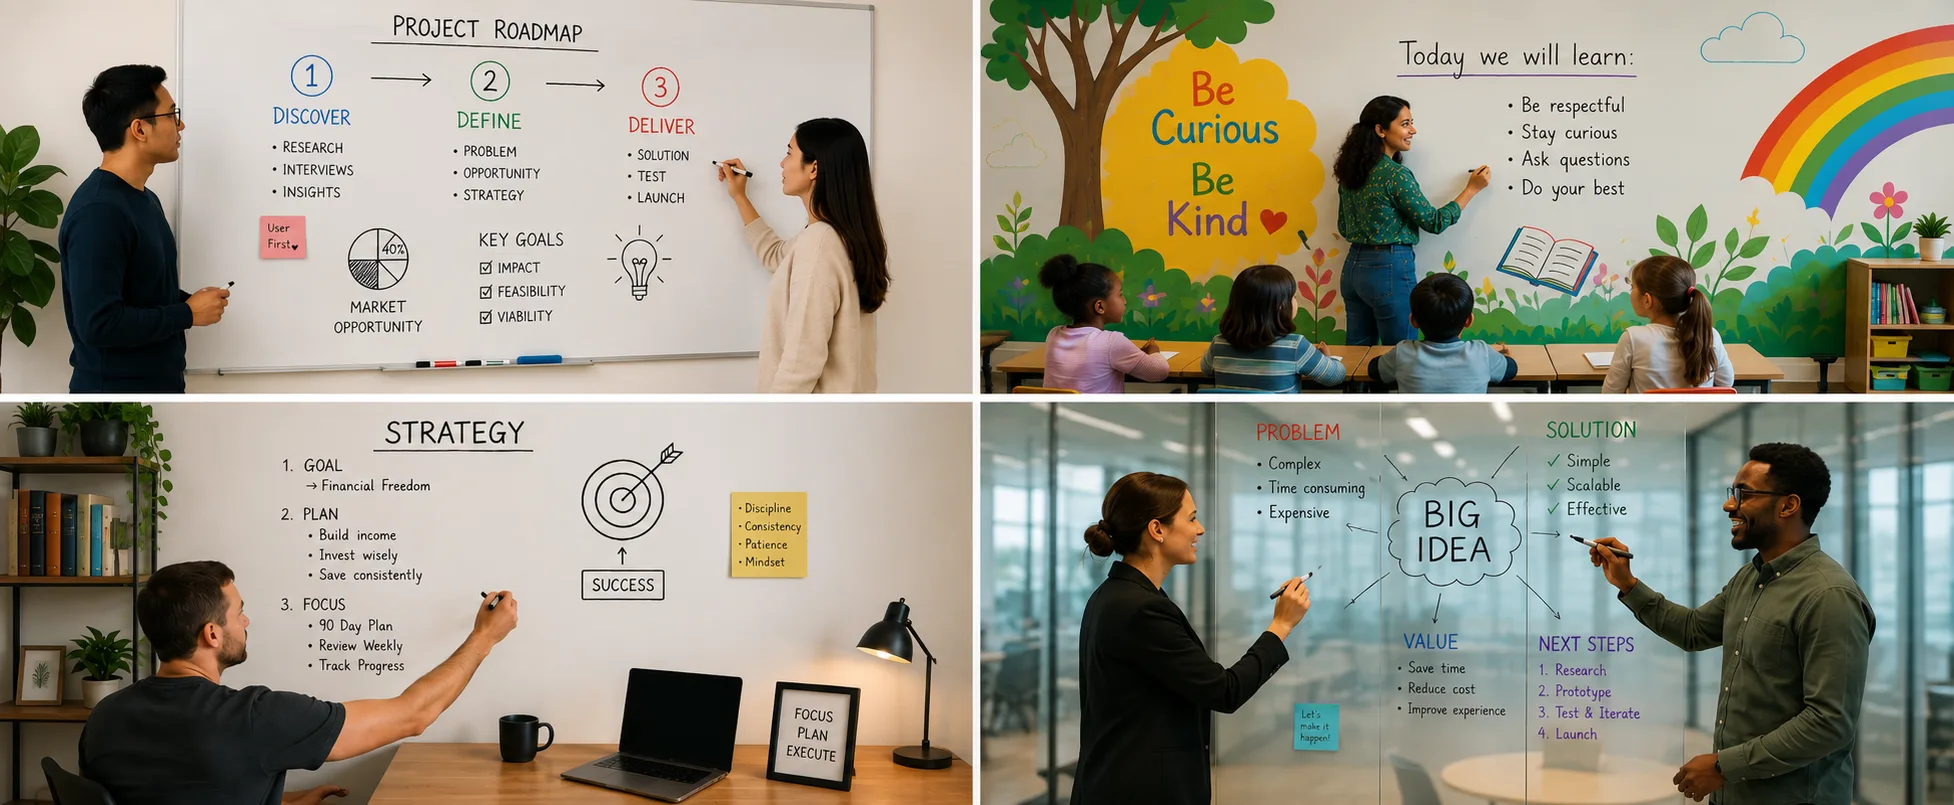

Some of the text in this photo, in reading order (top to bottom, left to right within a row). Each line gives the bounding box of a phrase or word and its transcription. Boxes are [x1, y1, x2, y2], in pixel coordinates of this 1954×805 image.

[393, 14, 583, 43] PROJECT ROADMAP
[1398, 39, 1634, 79] Today we will learn:
[305, 63, 318, 87] 1
[482, 69, 498, 92] 2
[654, 76, 668, 99] 3
[1192, 70, 1235, 107] Be
[1522, 95, 1625, 120] Be respectful
[273, 106, 351, 126] DISCOVER
[457, 110, 522, 130] DEFINE
[628, 116, 696, 135] DELIVER
[1151, 108, 1279, 146] Curious
[1521, 123, 1618, 147] Stay curious
[283, 140, 343, 154] RESEARCH
[463, 144, 517, 158] PROBLEM
[637, 148, 690, 162] SOLUTION
[1521, 149, 1630, 173] Ask questions
[283, 163, 354, 177] INTERVIEWS
[463, 166, 541, 180] OPPORTUNITY
[637, 170, 667, 183] TEST
[1192, 161, 1235, 197] Be
[283, 185, 341, 199] INSIGHTS
[463, 188, 525, 201] STRATEGY
[637, 191, 685, 204] LAUNCH
[1522, 178, 1625, 202] Do your best
[1167, 199, 1248, 237] Kind
[267, 223, 290, 233] User
[267, 238, 291, 250] First
[479, 231, 564, 248] KEY GOALS
[382, 243, 405, 255] 40%
[498, 261, 541, 274] IMPACT
[498, 284, 566, 298] FEASIBILITY
[350, 300, 407, 314] MARKET
[497, 309, 553, 323] VIABILITY
[333, 319, 423, 334] OPPORTUNITY
[384, 420, 525, 445] STRATEGY
[1256, 422, 1340, 441] PROBLEM
[1546, 419, 1638, 441] SOLUTION
[282, 458, 343, 473] 1. GOAL
[1268, 455, 1321, 476] Complex
[1567, 452, 1611, 473] Simple
[321, 478, 431, 492] Financial Freedom
[1268, 479, 1366, 500] Time consuming
[1566, 476, 1621, 492] Scalable
[280, 506, 339, 521] 2. PLAN
[745, 502, 792, 517] Discipline
[1269, 504, 1330, 524] Expensive
[1425, 499, 1481, 529] BIG
[1567, 500, 1628, 516] Effective
[319, 527, 397, 541] Build income
[744, 520, 802, 535] Consistency
[745, 537, 788, 550] Patience
[1418, 536, 1491, 563] IDEA
[319, 548, 398, 566] Invest wisely
[745, 555, 785, 568] Mindset
[319, 567, 423, 586] Save consistently
[592, 577, 655, 592] SUCCESS
[280, 597, 346, 612] 3. FOCUS
[319, 618, 393, 636] 90 Day Plan
[319, 638, 403, 656] Review Weekly
[1403, 632, 1458, 652] VALUE
[1539, 635, 1635, 653] NEXT STEPS
[318, 658, 405, 676] Track Progress
[1408, 660, 1466, 674] Save time
[1539, 662, 1607, 677] 1. Research
[1408, 681, 1476, 695] Reduce cost
[1538, 683, 1612, 703] 2. Prototype
[794, 707, 834, 723] FOCUS
[1301, 709, 1321, 719] Let's
[1408, 703, 1506, 720] Improve experience
[1538, 705, 1641, 720] 3. Test & Iterate
[797, 726, 829, 742] PLAN
[1300, 722, 1330, 731] make it
[1537, 726, 1598, 740] 4. Launch
[1300, 732, 1331, 745] happen!
[786, 744, 837, 763] EXECUTE
